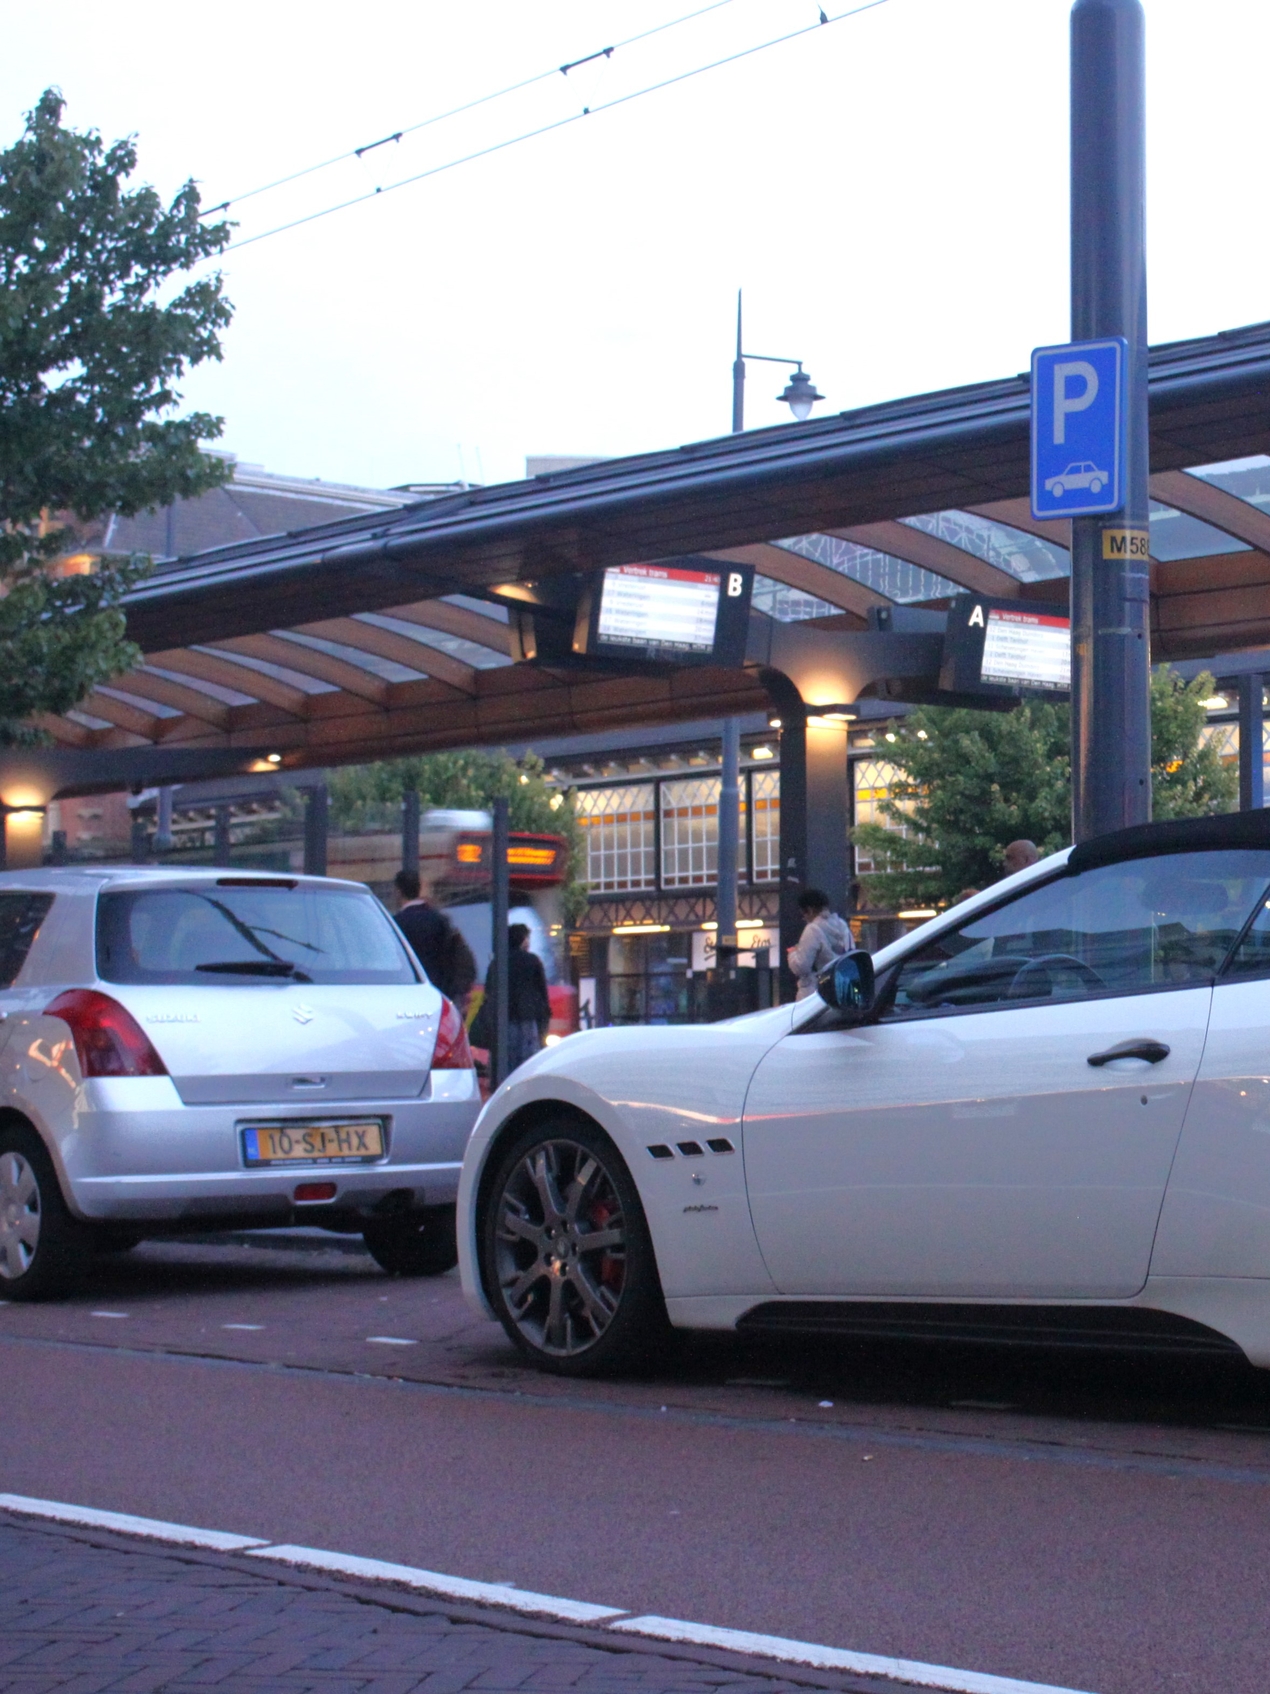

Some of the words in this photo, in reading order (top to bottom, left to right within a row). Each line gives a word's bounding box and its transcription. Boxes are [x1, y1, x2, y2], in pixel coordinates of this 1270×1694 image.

[1053, 360, 1099, 445] P
[1110, 535, 1149, 556] M58
[727, 572, 743, 597] B
[968, 604, 984, 628] A
[269, 1130, 369, 1155] 10-SJ-HX
